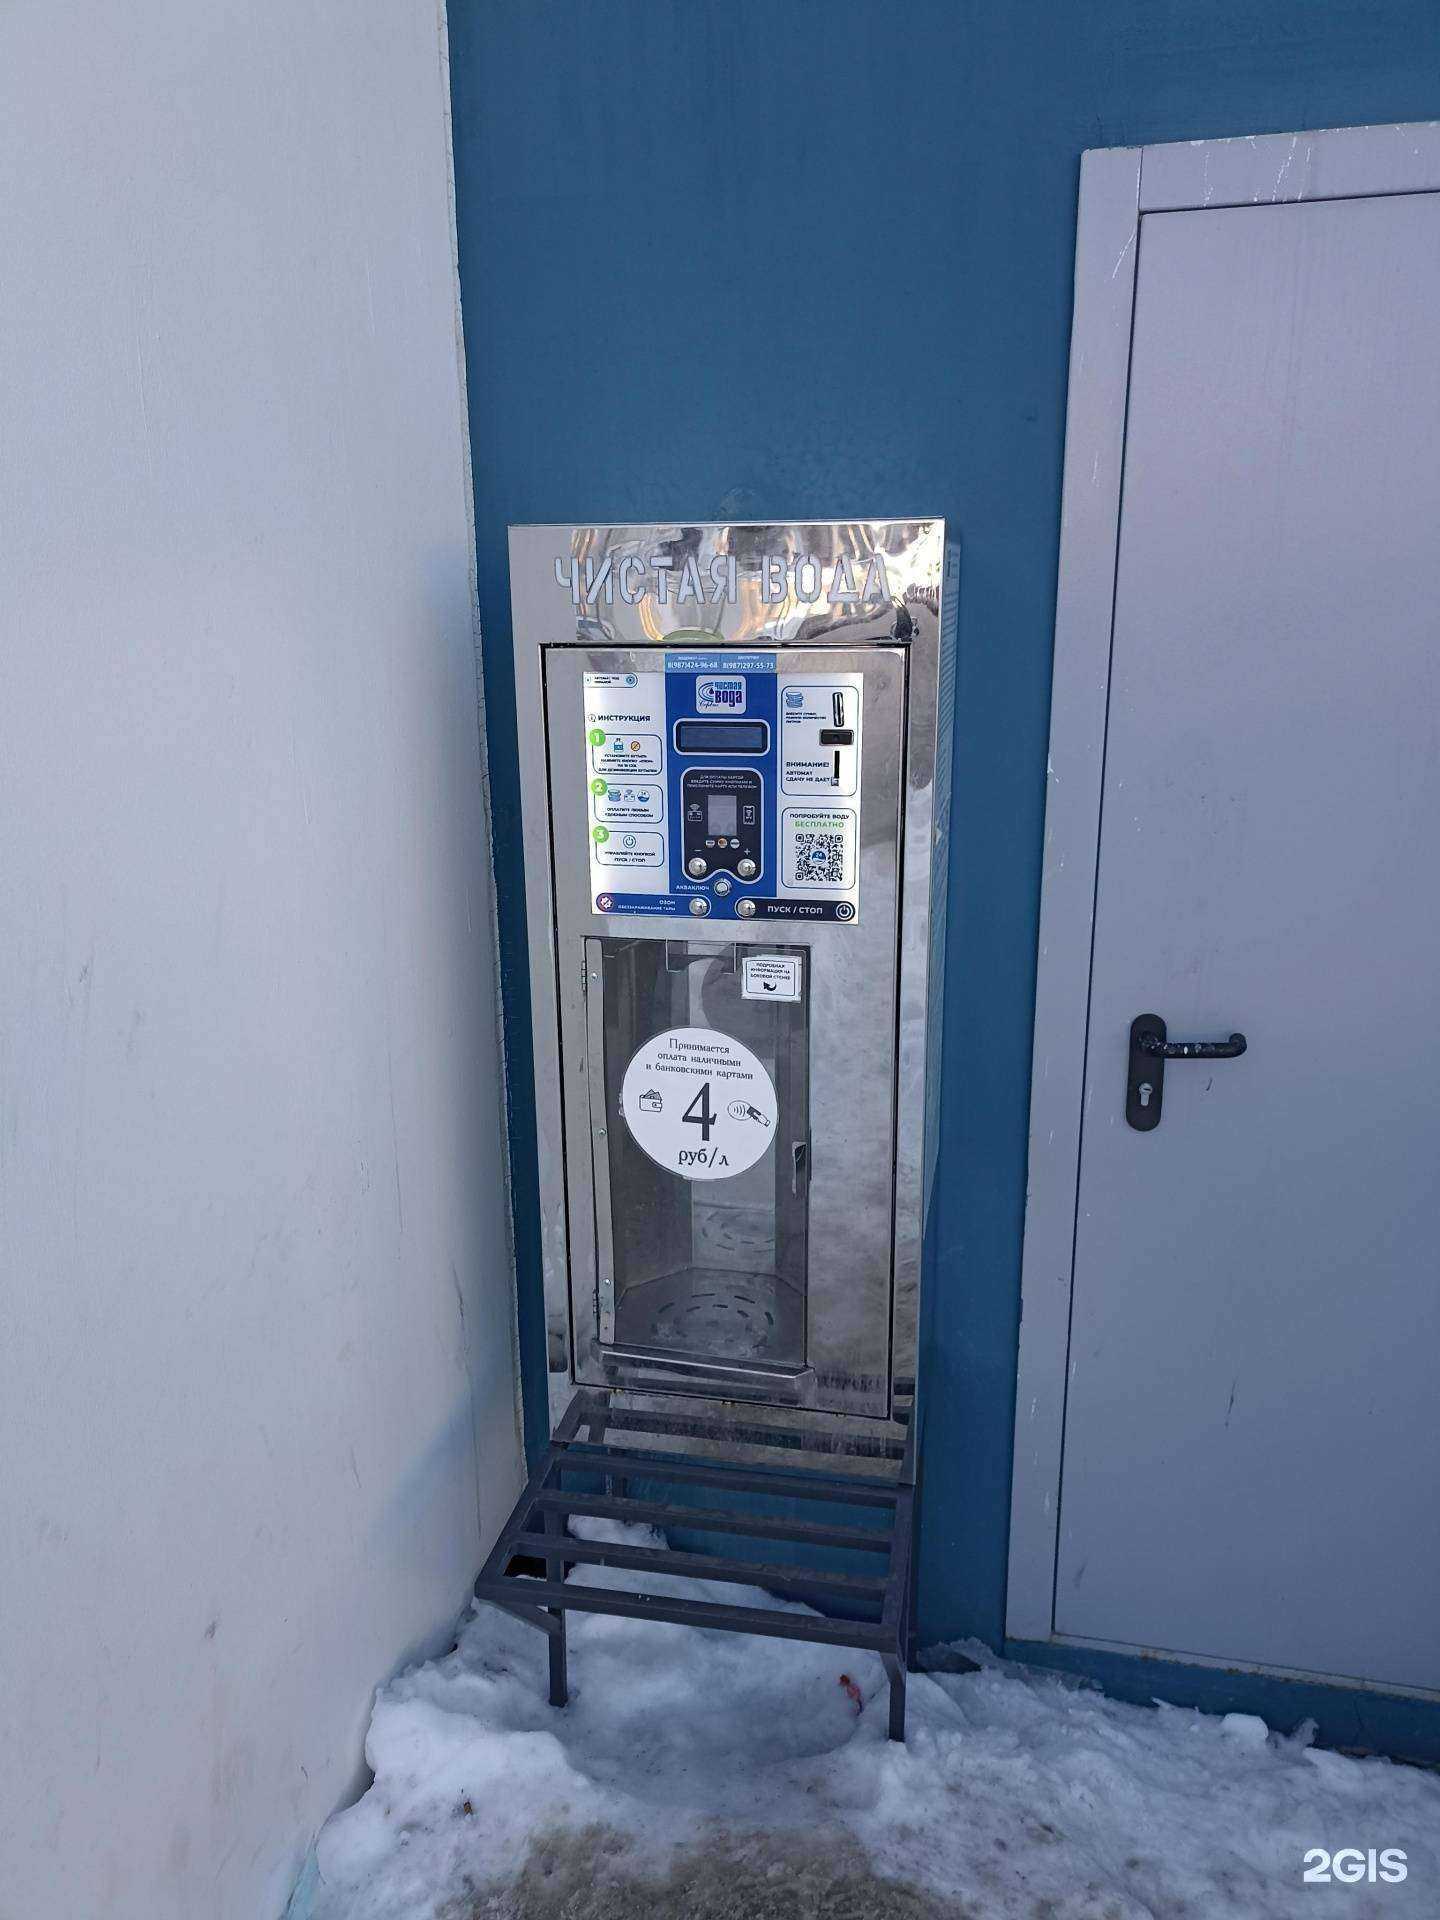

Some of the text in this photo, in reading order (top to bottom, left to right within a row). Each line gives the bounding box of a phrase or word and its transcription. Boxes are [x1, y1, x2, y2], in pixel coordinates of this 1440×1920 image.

[554, 552, 892, 605] ЧИСТАЯ ВОДА
[597, 714, 651, 722] ИНСТРУКЦИЯ
[767, 905, 791, 913] ПУСК
[798, 906, 824, 914] СТОП
[669, 1038, 731, 1054] Принимается
[657, 1052, 742, 1068] оплата наличными
[645, 1062, 754, 1080] и банковскими картами
[681, 1082, 718, 1142] 4
[677, 1146, 730, 1169] руб/л
